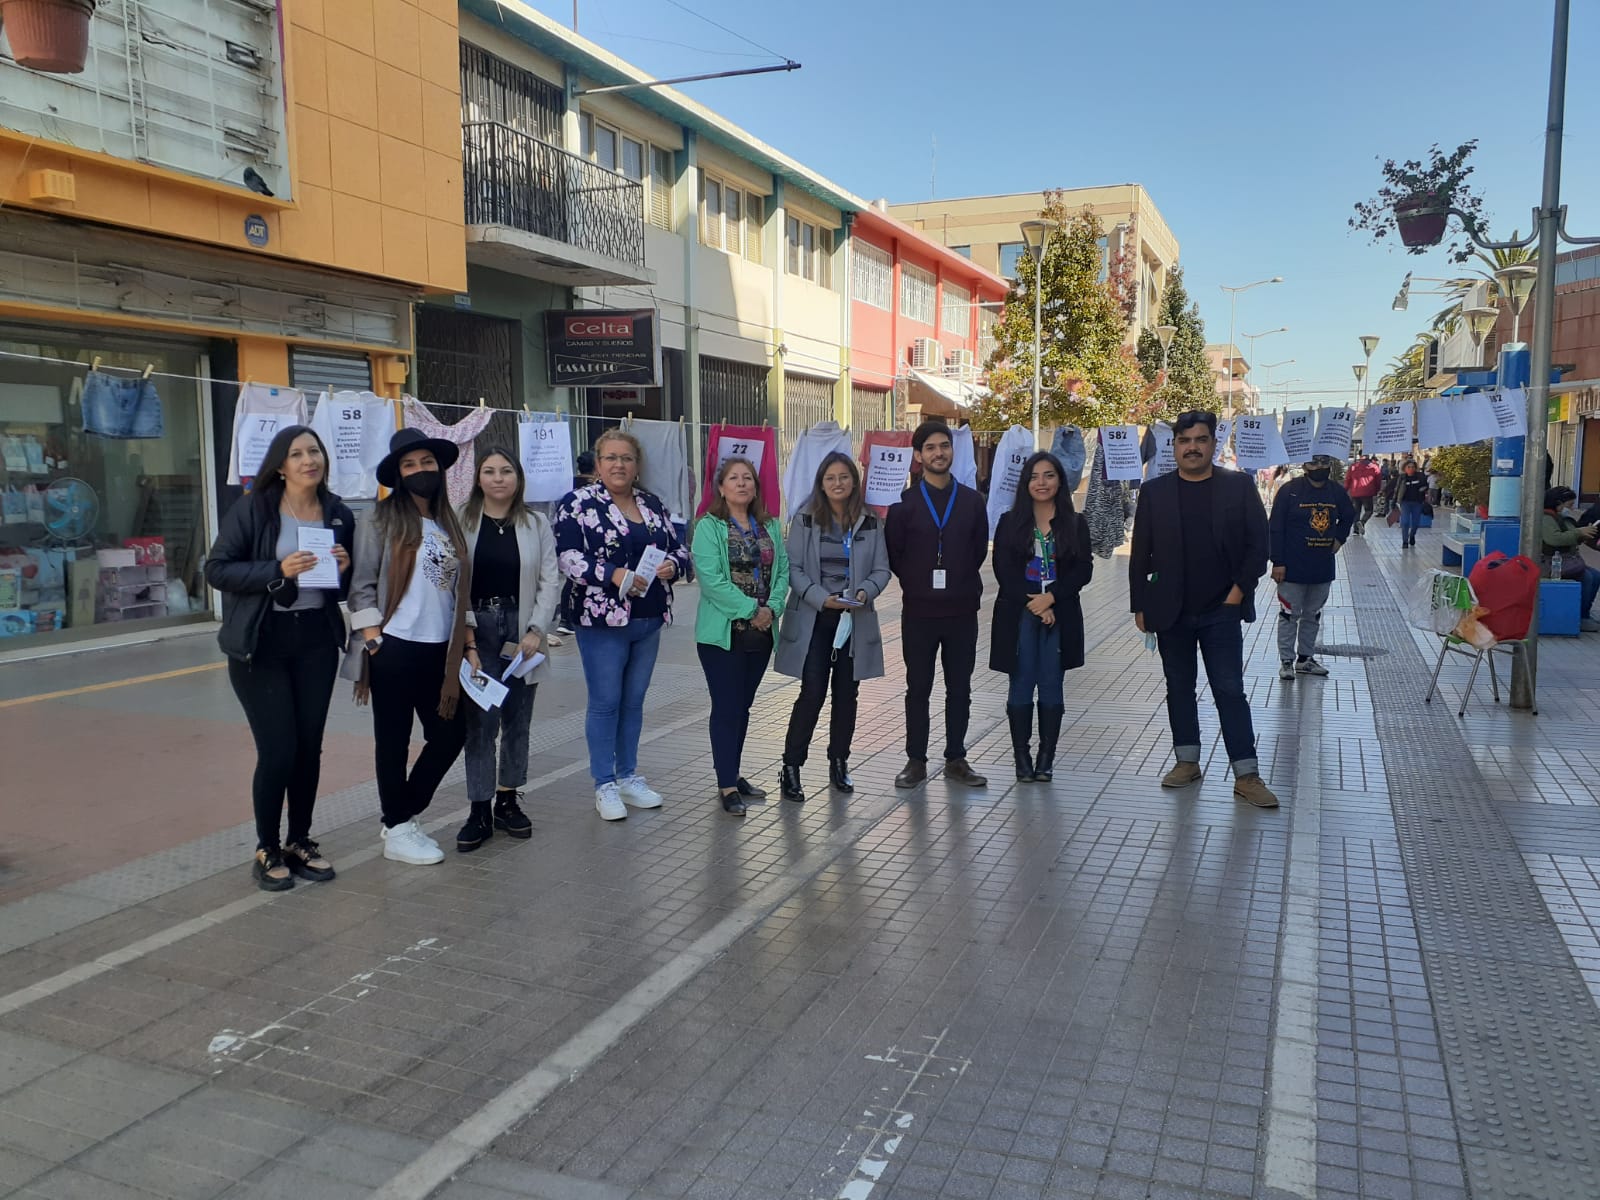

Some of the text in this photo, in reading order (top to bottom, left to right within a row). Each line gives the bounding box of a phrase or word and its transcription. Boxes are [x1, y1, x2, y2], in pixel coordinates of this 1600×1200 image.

[248, 224, 265, 238] ADT
[568, 321, 630, 335] Celta
[1382, 406, 1401, 415] 587
[1291, 416, 1306, 426] 154
[1332, 411, 1351, 422] 191
[259, 419, 277, 433] 77
[1243, 420, 1261, 429] 587
[533, 428, 554, 440] 191
[1108, 430, 1127, 440] 587
[732, 443, 748, 454] 77
[880, 451, 903, 463] 191
[1011, 454, 1027, 465] 191
